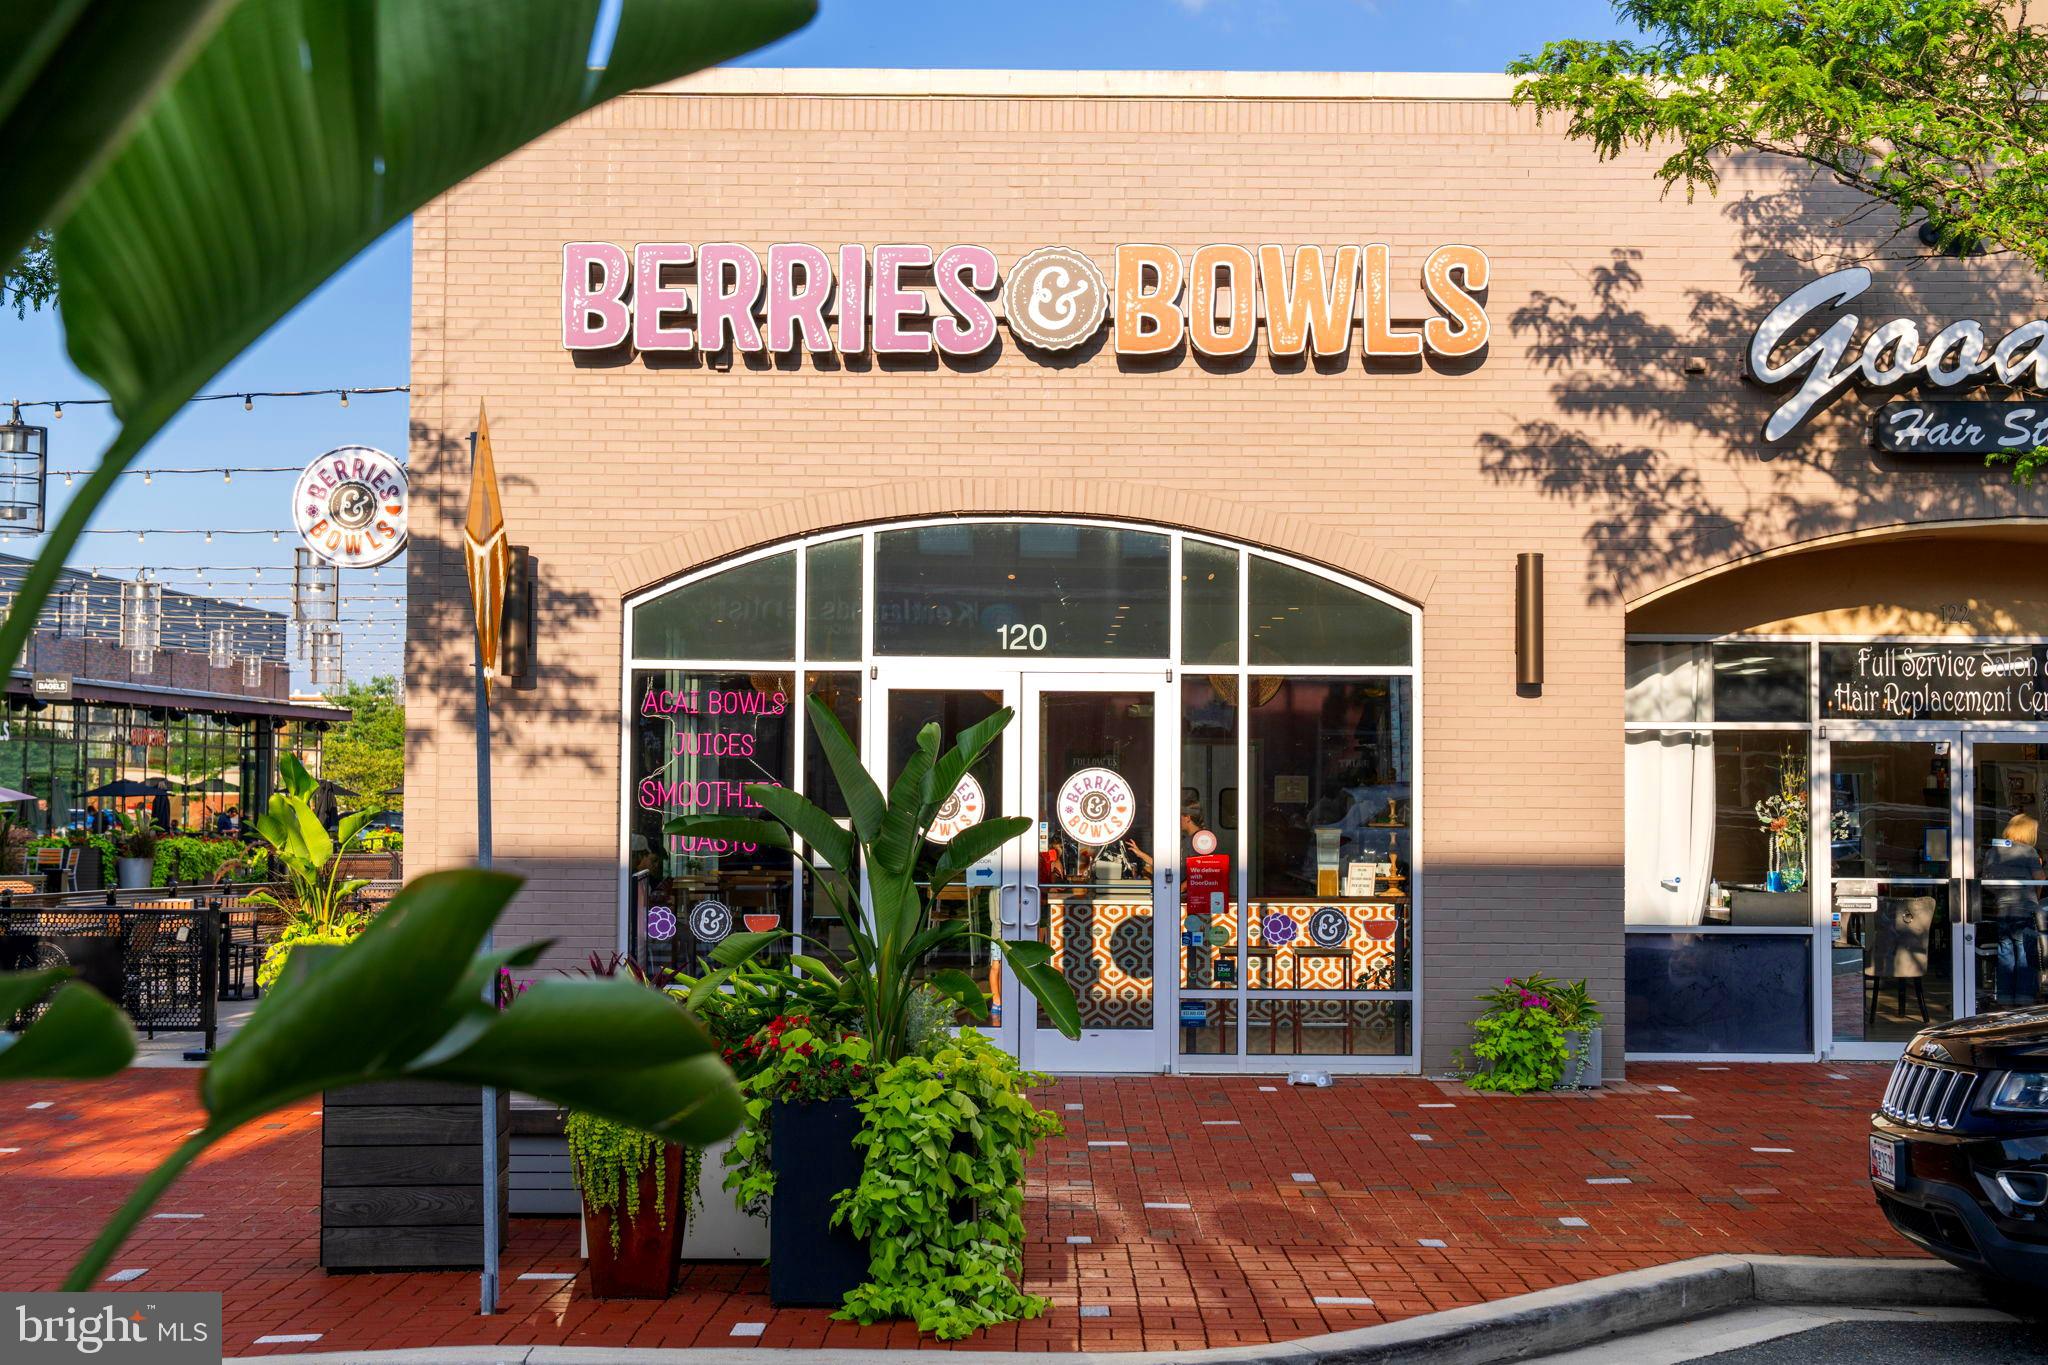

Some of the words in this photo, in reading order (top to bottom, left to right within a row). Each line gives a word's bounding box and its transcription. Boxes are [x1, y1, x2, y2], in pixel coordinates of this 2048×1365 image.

[562, 241, 999, 356] BERRIES
[1114, 242, 1491, 356] BOWLS
[1889, 408, 1985, 446] Hair
[307, 457, 400, 501] BERRIES
[340, 489, 369, 521] &
[309, 518, 396, 556] BOWLS
[1941, 604, 1970, 624] 122
[996, 623, 1048, 651] 120
[1858, 646, 1896, 677] Full
[1901, 647, 1977, 680] Service
[1980, 648, 2038, 677] Salon
[643, 690, 700, 714] ACAI
[708, 690, 786, 715] BOWLS
[1834, 682, 1880, 712] Hair
[1884, 682, 2012, 719] Replacement
[672, 732, 755, 757] JUICES
[1072, 757, 1104, 766] FOLLOW
[1107, 757, 1118, 767] US
[640, 780, 784, 808] SMOOTHI
[1066, 775, 1125, 803] BERRIES
[1069, 815, 1123, 838] BOWLS
